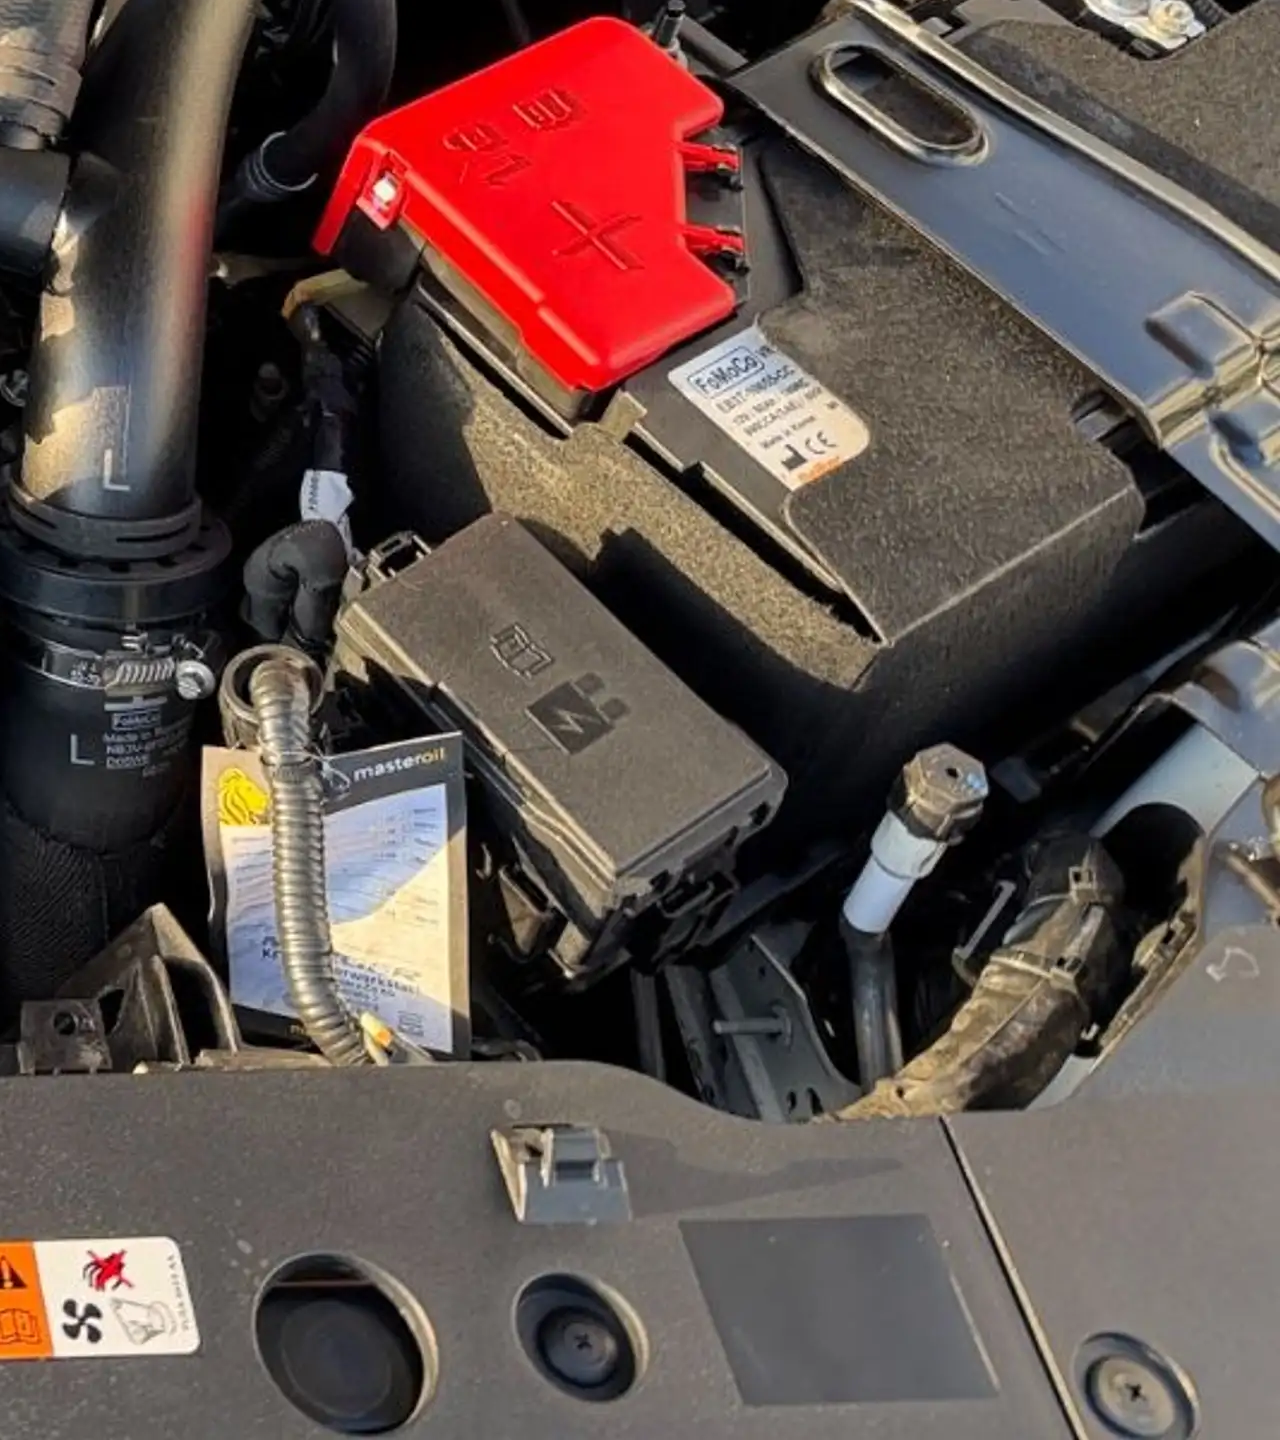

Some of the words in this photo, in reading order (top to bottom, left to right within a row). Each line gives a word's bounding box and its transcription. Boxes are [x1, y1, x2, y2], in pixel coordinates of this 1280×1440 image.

[694, 355, 758, 393] FoMoCo
[103, 448, 131, 491] L
[70, 734, 95, 765] L
[353, 747, 446, 782] masteroil
